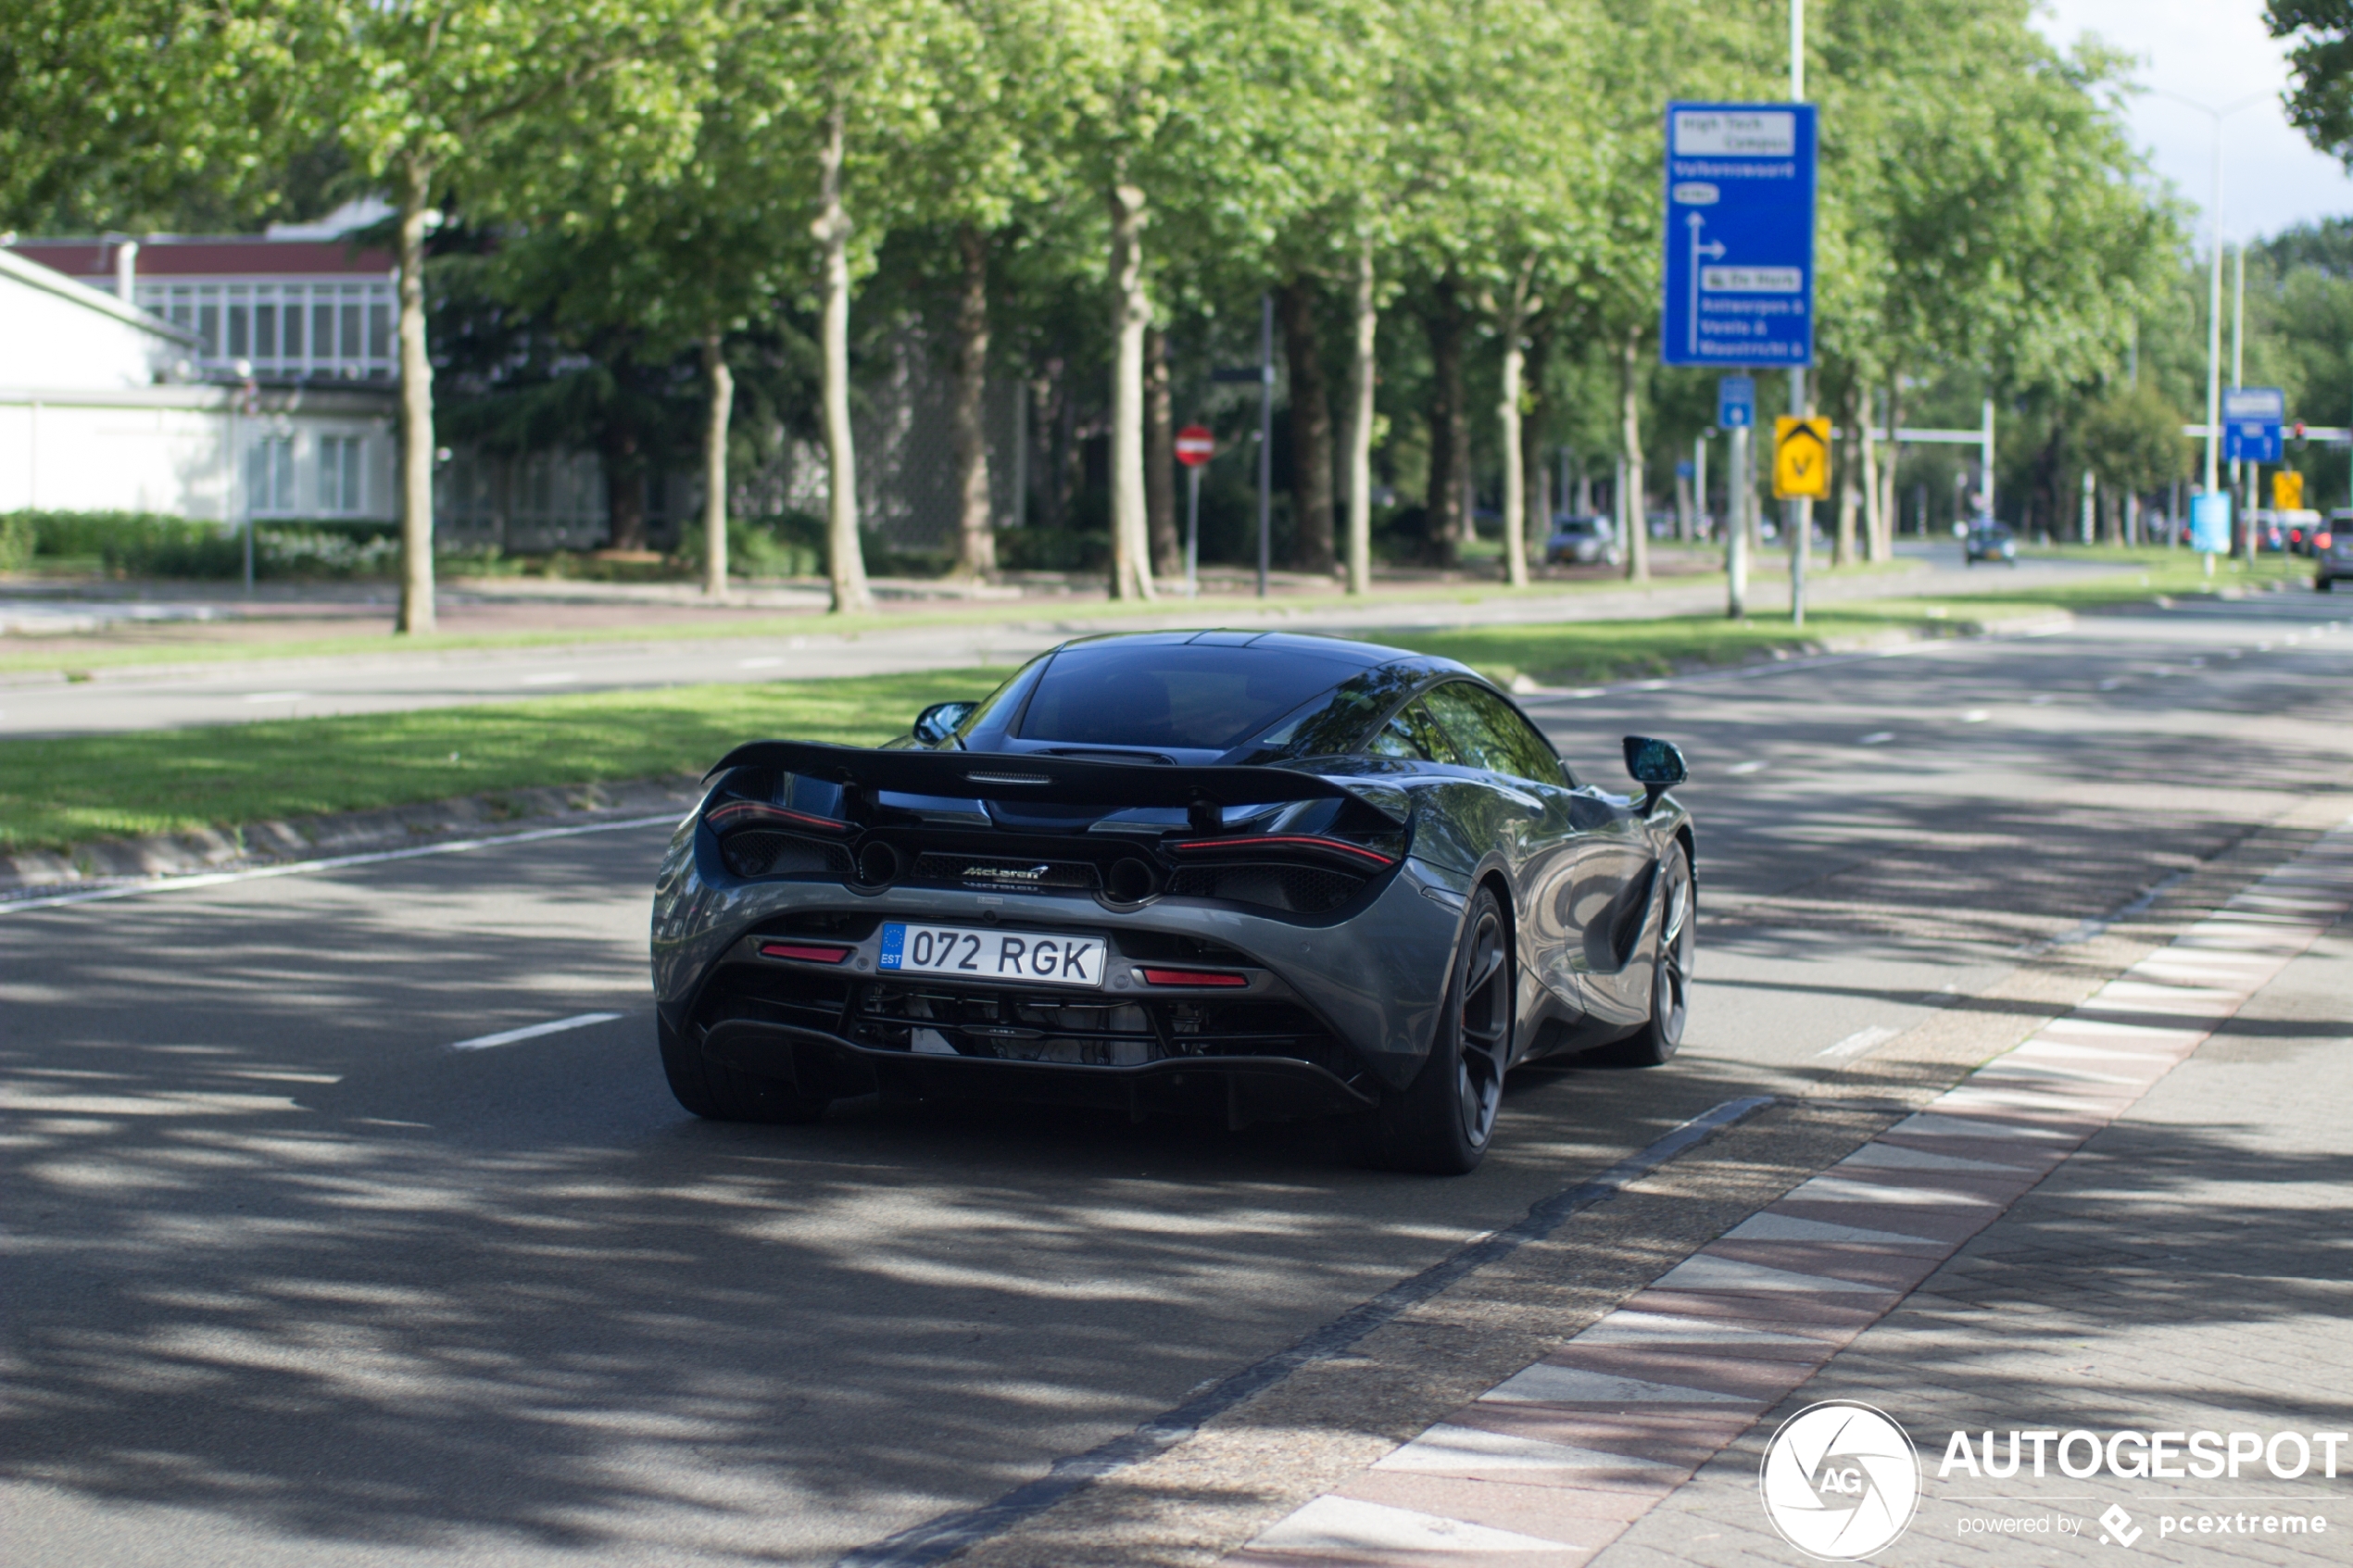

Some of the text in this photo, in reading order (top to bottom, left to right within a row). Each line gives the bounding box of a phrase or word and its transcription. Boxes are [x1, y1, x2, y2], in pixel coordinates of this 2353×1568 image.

[963, 867, 1039, 879] McLaren
[881, 954, 901, 964] EST
[912, 931, 1092, 979] 072 RGK
